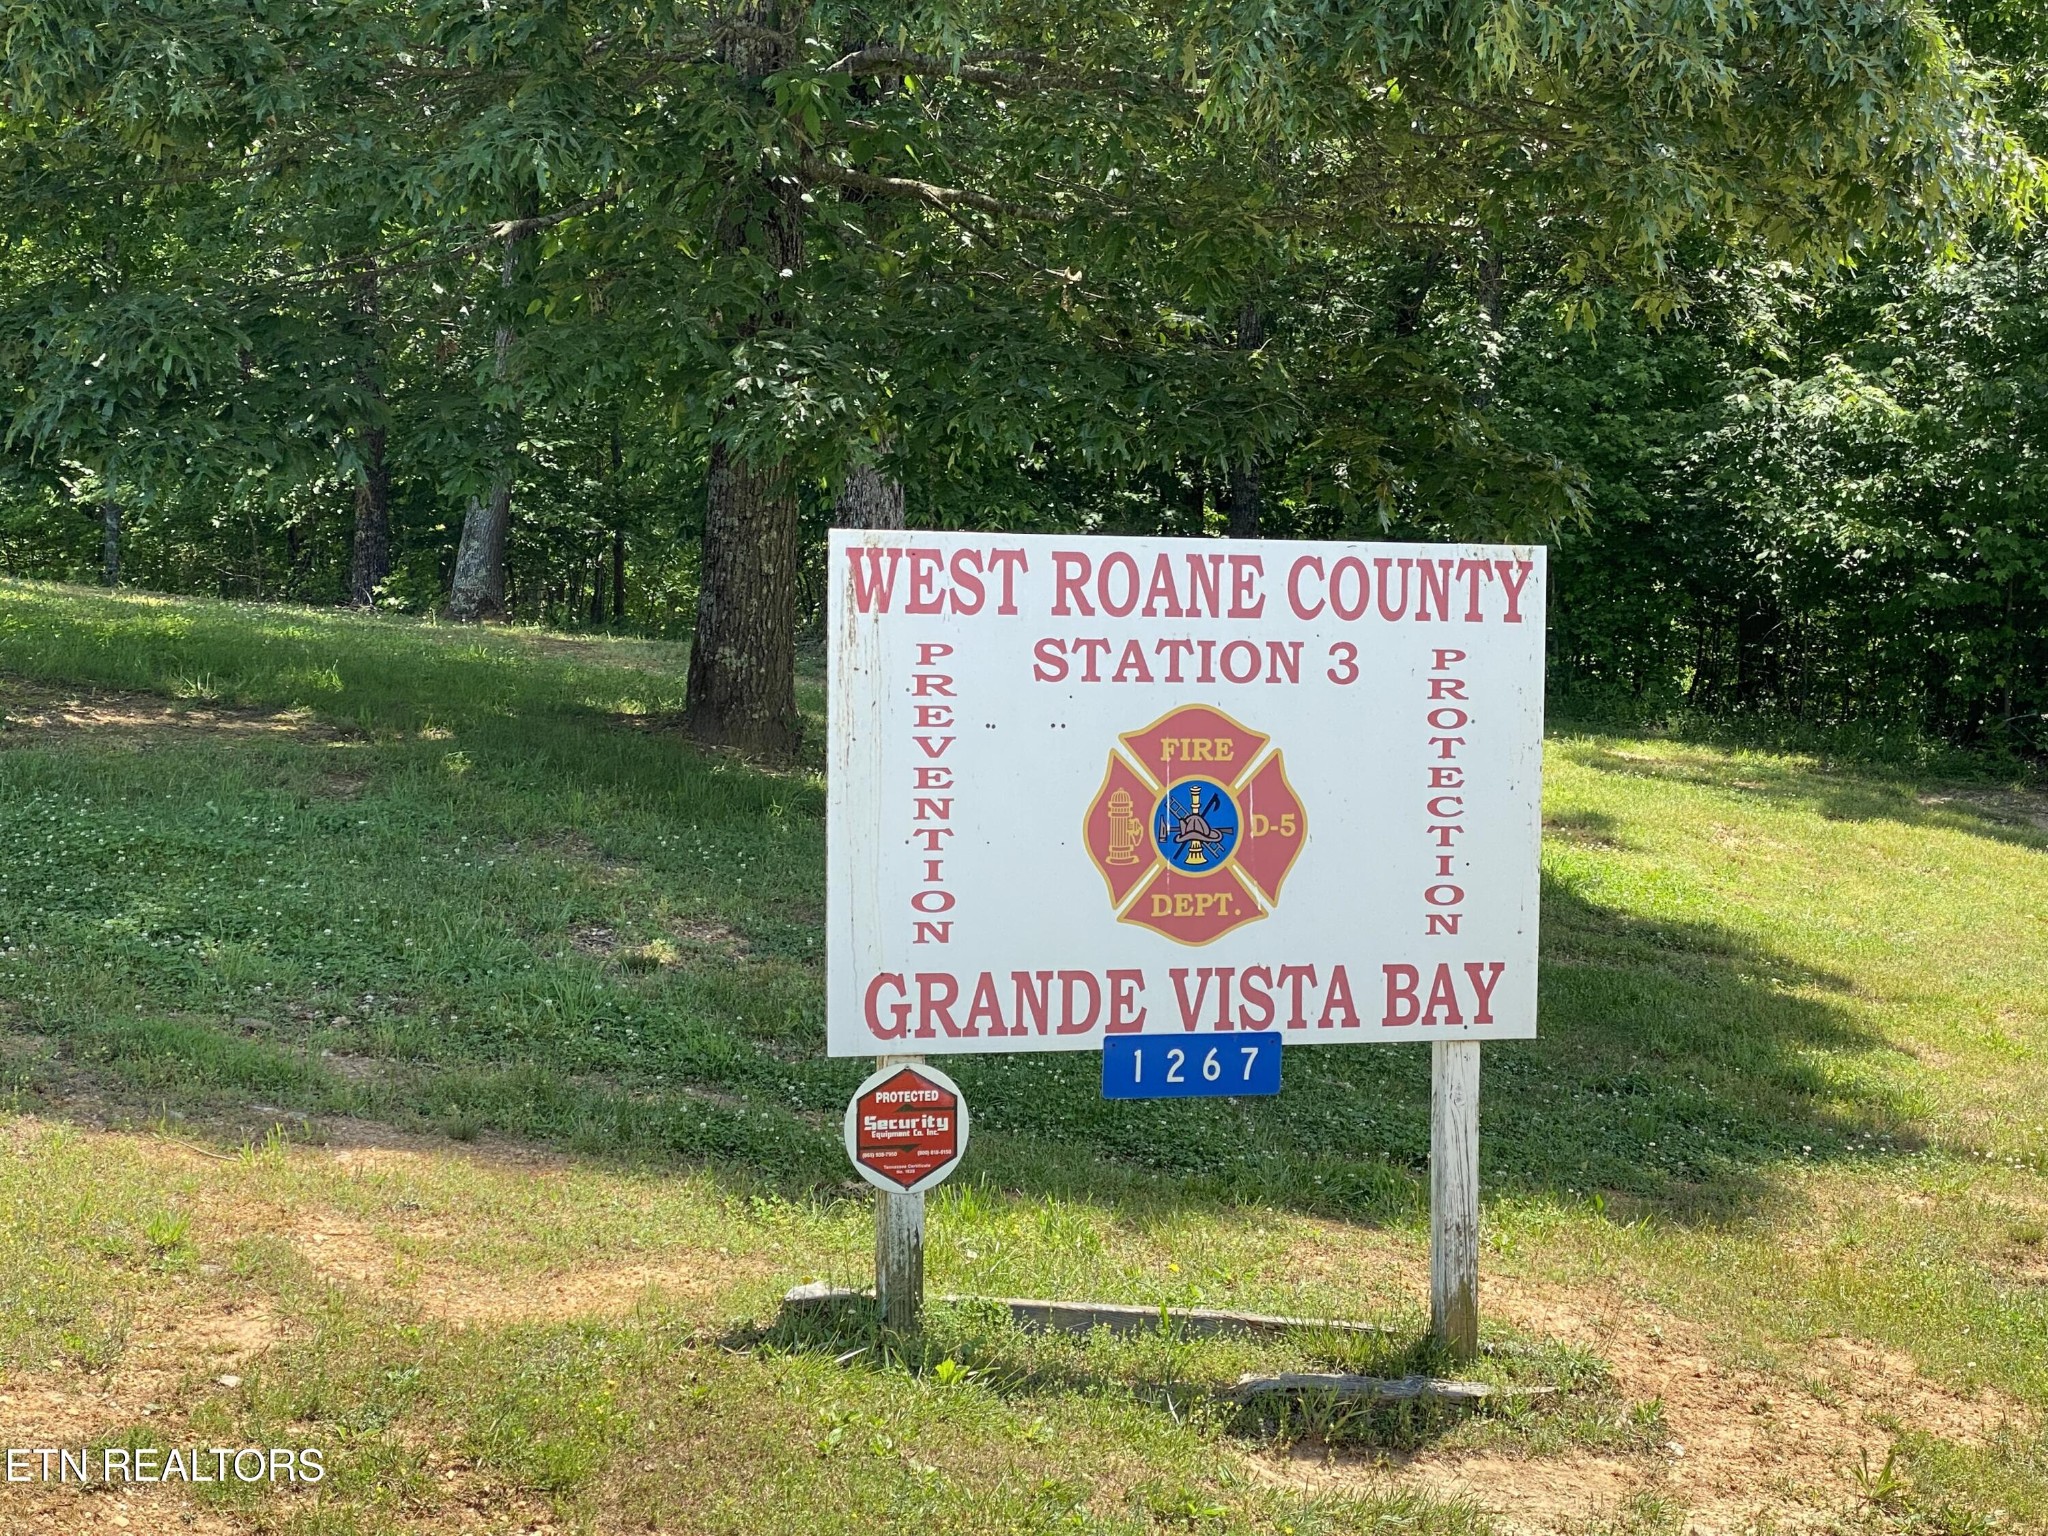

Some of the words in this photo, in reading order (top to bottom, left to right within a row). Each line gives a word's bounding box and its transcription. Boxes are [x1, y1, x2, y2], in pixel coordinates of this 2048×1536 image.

[845, 547, 1029, 616] WEST
[1050, 550, 1267, 619] ROANE
[1287, 554, 1534, 624] COUNTY
[1033, 637, 1305, 684] STATION
[1326, 641, 1360, 686] 3
[1160, 737, 1235, 762] FIRE
[911, 643, 958, 945] PREVENTION
[1424, 648, 1470, 936] PROTECTION
[1251, 812, 1297, 838] D-5
[1151, 892, 1242, 918] DEPT.
[864, 968, 1148, 1041] GRANDE
[1168, 963, 1361, 1033] VISTA
[1381, 962, 1506, 1028] BAY
[1133, 1047, 1259, 1083] 1267
[875, 1090, 939, 1104] PROTECTED
[863, 1114, 949, 1132] Security
[871, 1129, 910, 1140] Equipment
[912, 1128, 924, 1137] Co.
[926, 1128, 940, 1136] Inc.
